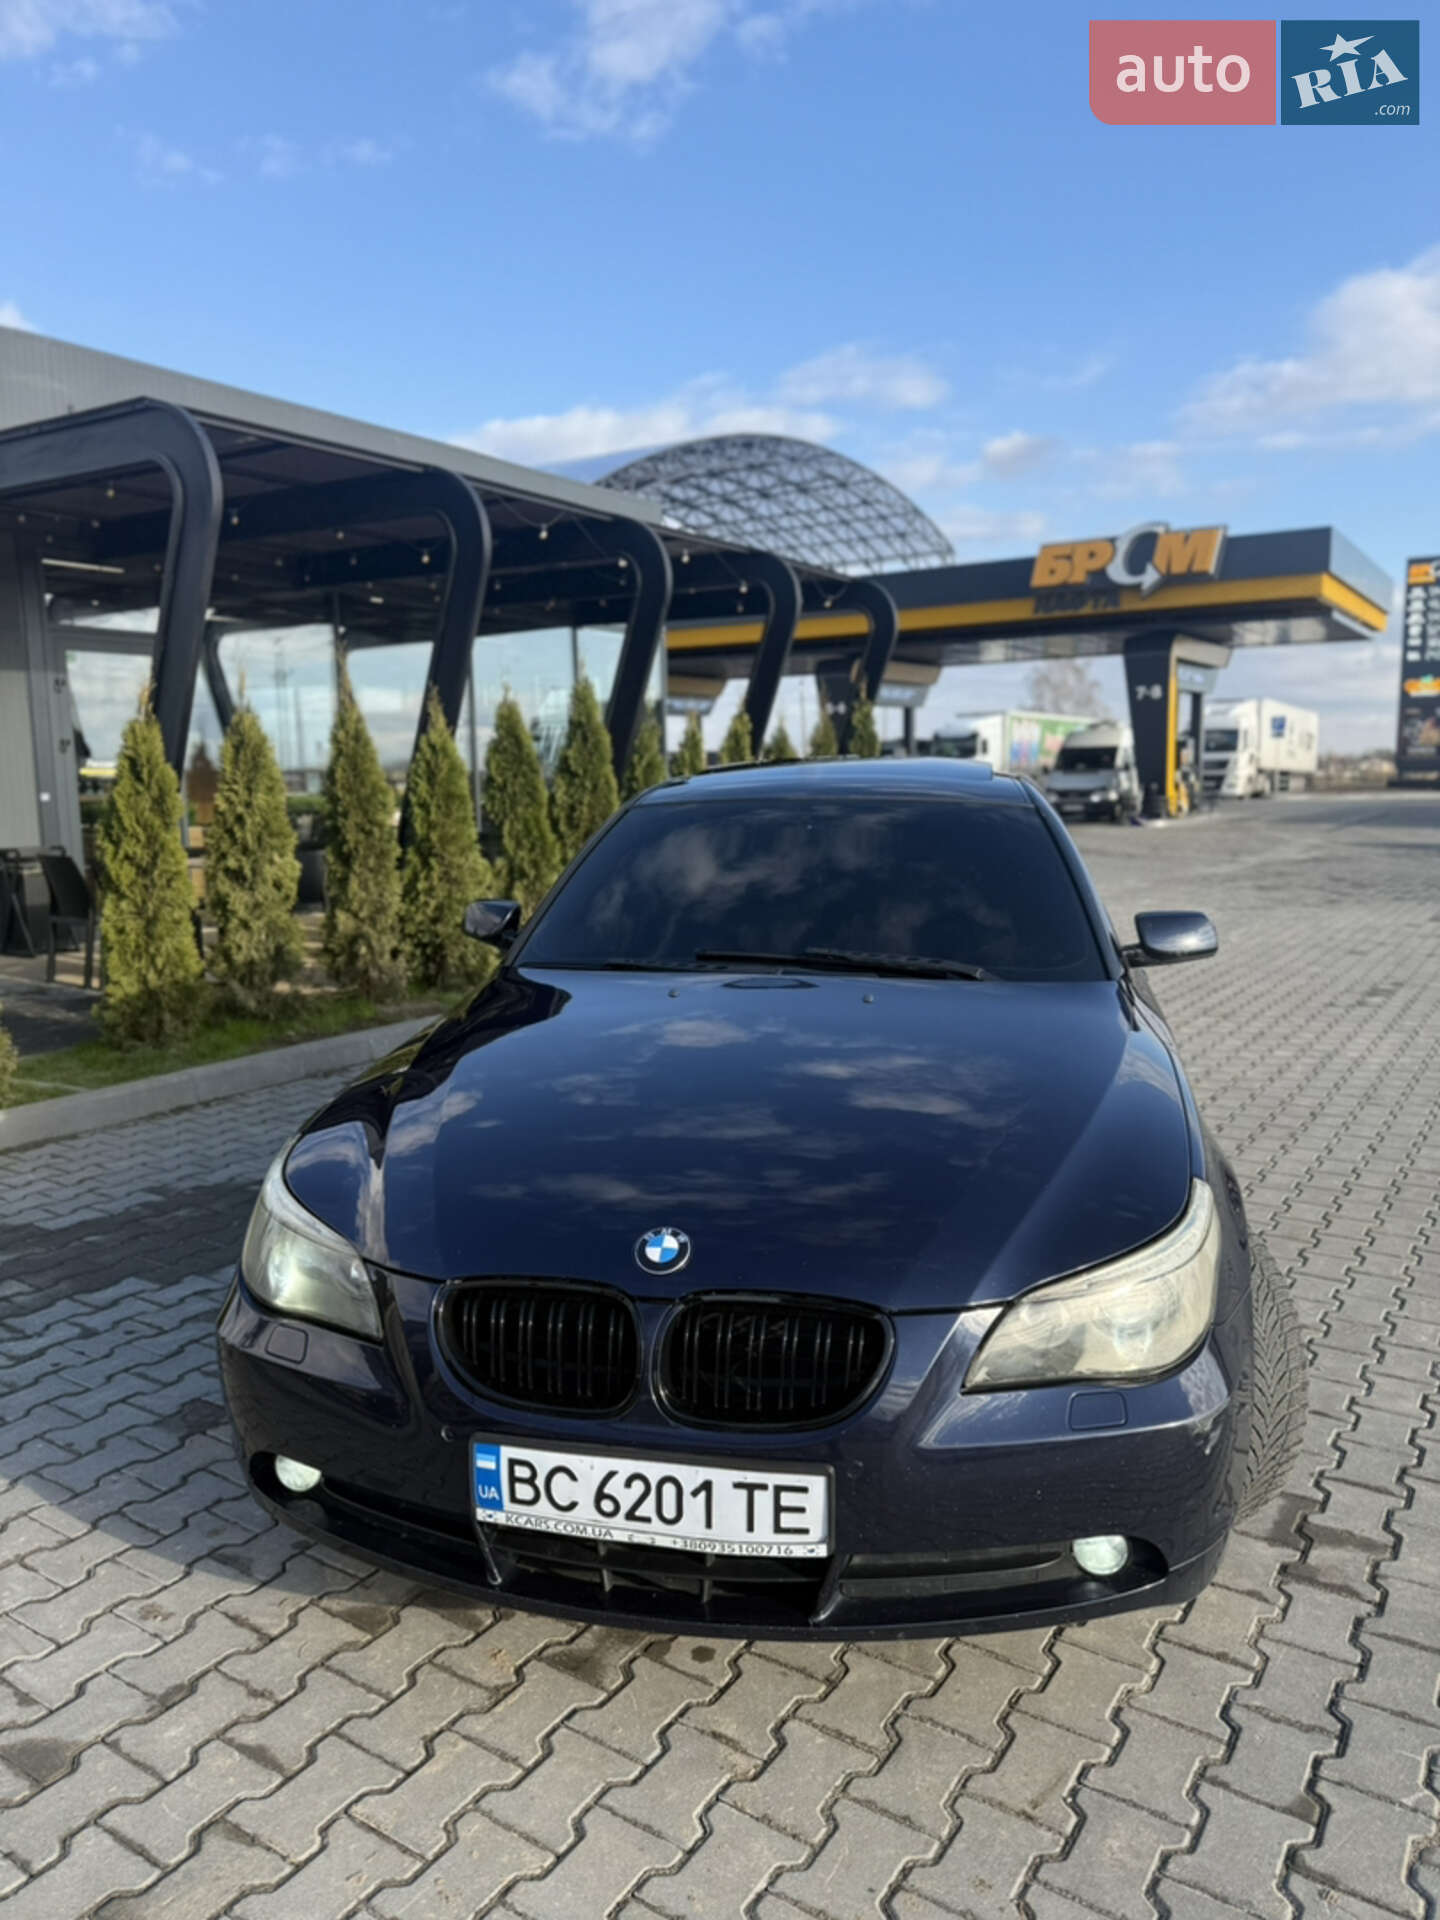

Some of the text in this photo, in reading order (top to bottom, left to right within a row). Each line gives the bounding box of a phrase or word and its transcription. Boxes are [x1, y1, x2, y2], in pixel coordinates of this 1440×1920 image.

[1030, 522, 1226, 597] БРСМ
[478, 1484, 499, 1501] UA
[507, 1457, 810, 1535] BC 6201 TE
[505, 1513, 614, 1540] KCARS.COM.UA
